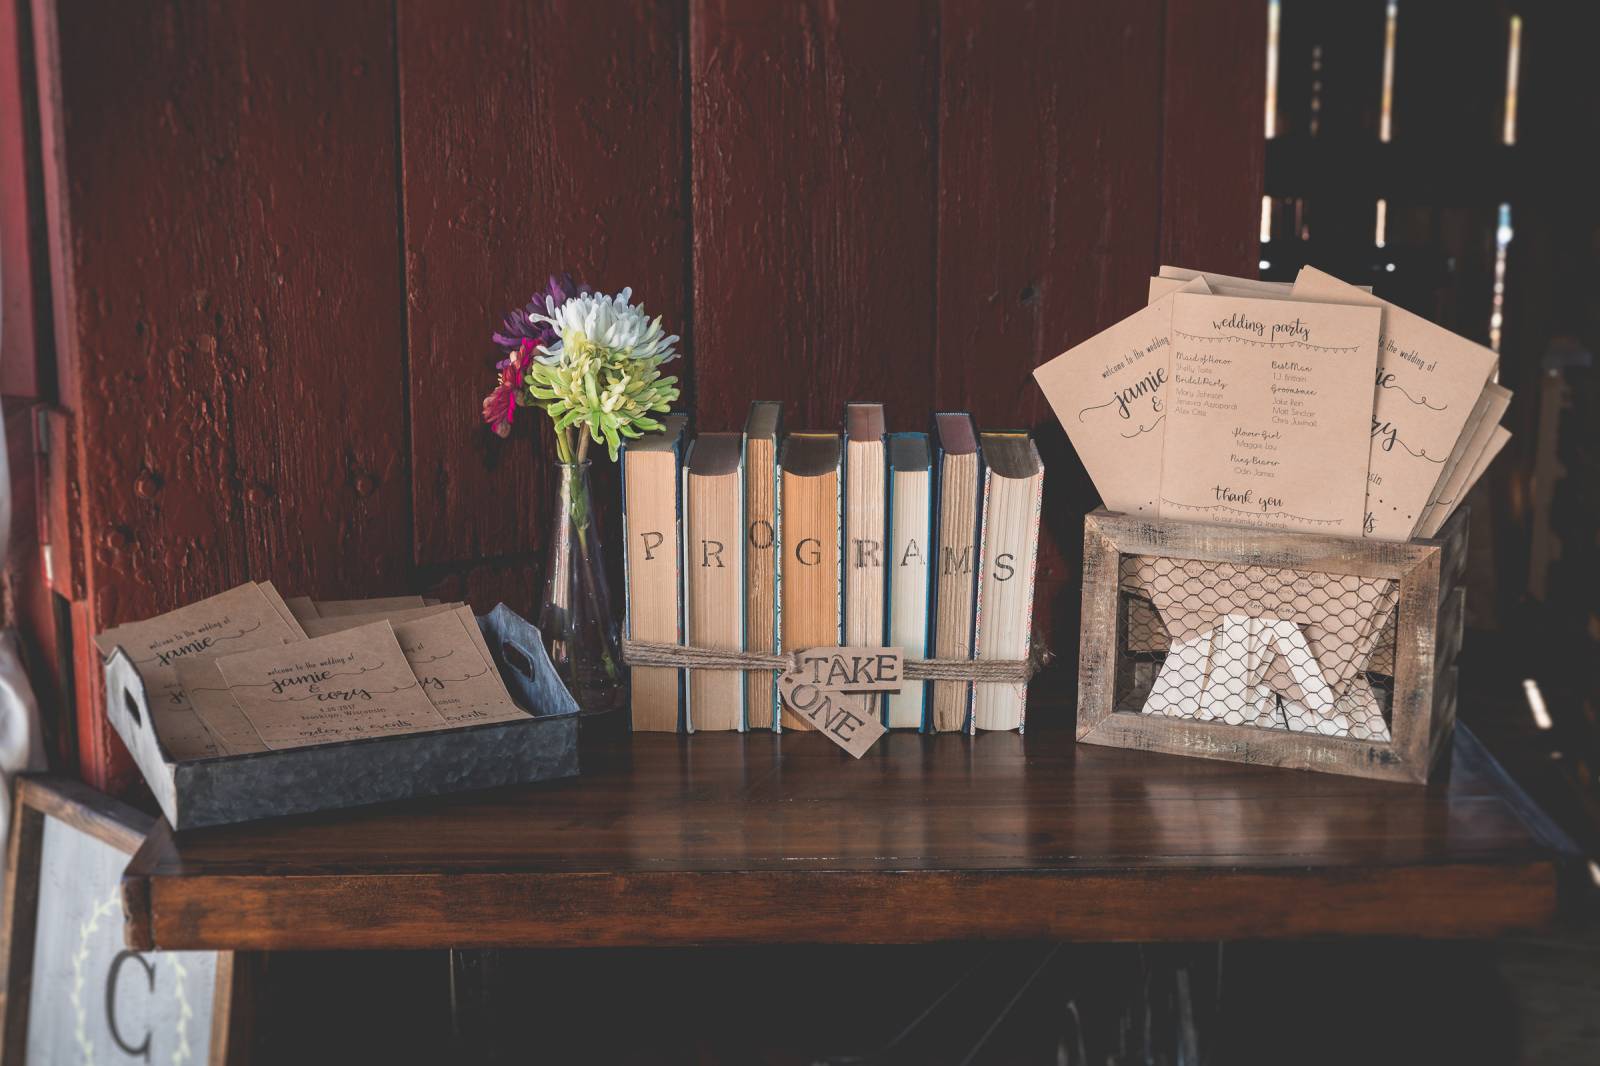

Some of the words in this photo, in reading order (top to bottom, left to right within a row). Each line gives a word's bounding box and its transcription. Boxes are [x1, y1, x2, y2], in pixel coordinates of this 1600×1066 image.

[1212, 313, 1266, 337] wedding
[1271, 317, 1312, 342] party
[1102, 361, 1126, 379] welcome
[1133, 348, 1145, 361] the
[1271, 360, 1290, 370] Best
[1290, 362, 1313, 373] Man
[1386, 340, 1398, 354] the
[1399, 350, 1425, 371] wedding
[1427, 361, 1437, 373] of
[1108, 368, 1168, 420] jamie
[1210, 484, 1254, 505] thank
[1258, 496, 1284, 512] you
[156, 637, 213, 667] jamie
[319, 656, 346, 667] wedding
[271, 670, 332, 694] jamie
[804, 654, 898, 686] TAKE
[317, 687, 372, 701] cory
[790, 684, 866, 742] ONE
[104, 949, 156, 1065] C
